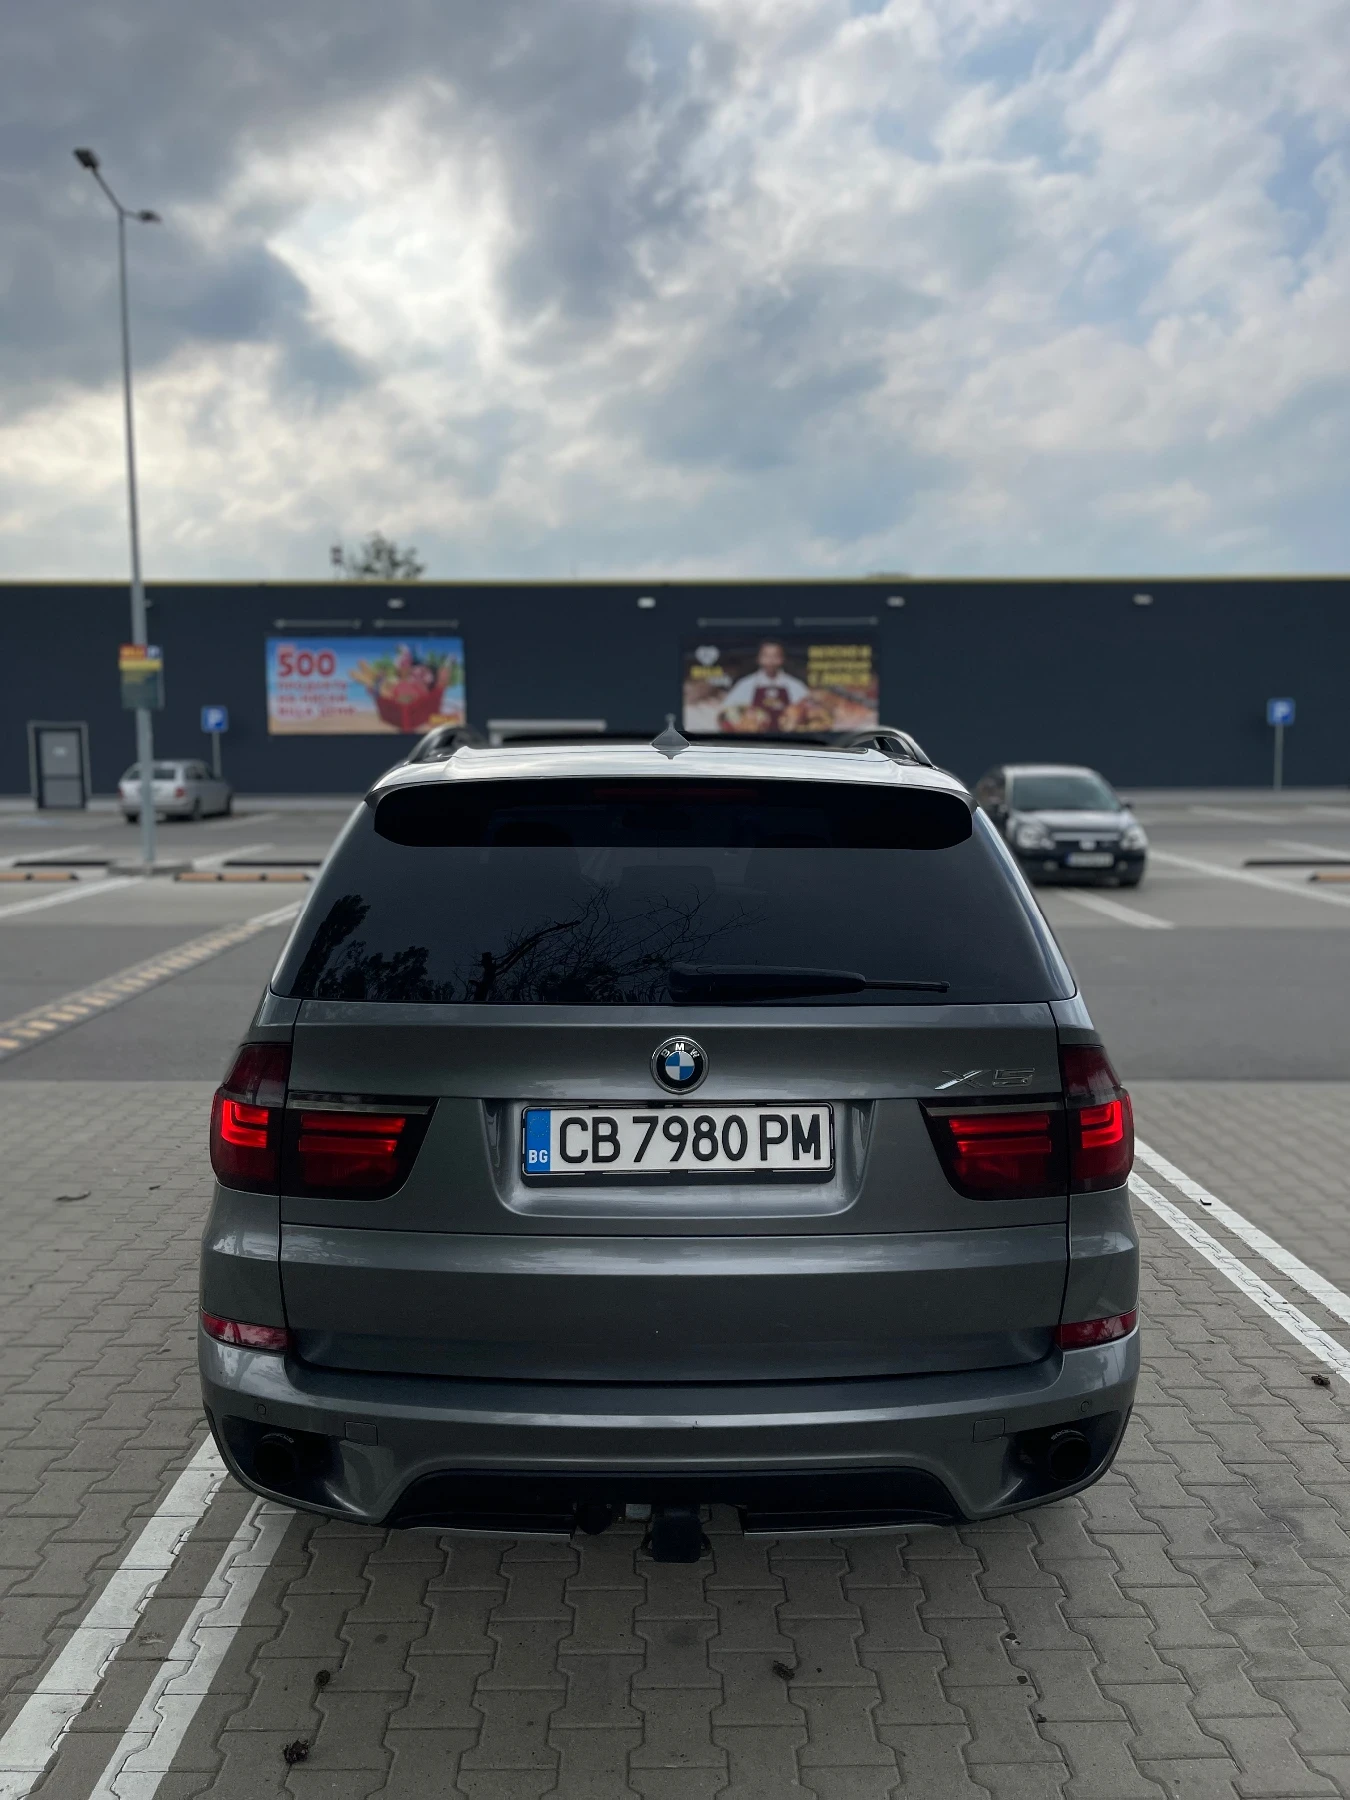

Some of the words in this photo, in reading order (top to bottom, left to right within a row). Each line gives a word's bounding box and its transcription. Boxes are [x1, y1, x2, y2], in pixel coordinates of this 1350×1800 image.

[278, 650, 336, 677] 500
[660, 1042, 700, 1059] BMW
[934, 1067, 1036, 1090] X5
[559, 1115, 621, 1164] CB
[632, 1114, 748, 1163] 7980
[758, 1113, 821, 1162] PM
[528, 1149, 548, 1164] BG
